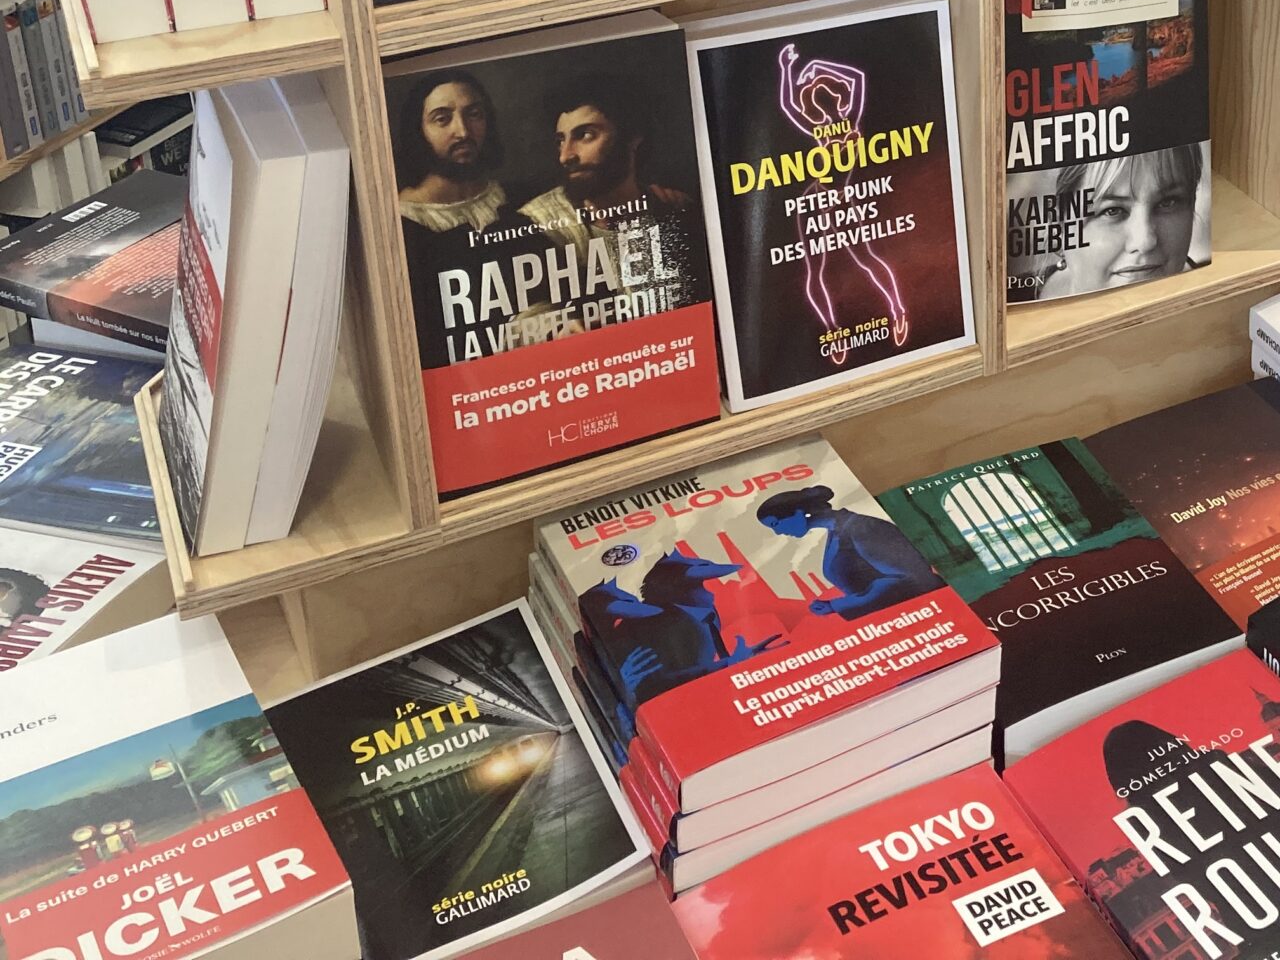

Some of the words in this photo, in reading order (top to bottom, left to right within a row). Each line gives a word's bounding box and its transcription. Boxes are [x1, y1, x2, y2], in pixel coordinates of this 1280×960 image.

[729, 122, 936, 197] DANQUIGNY
[1006, 105, 1131, 170] AFFRIC
[467, 214, 569, 249] Francesco
[574, 194, 649, 226] Fioretti
[784, 190, 841, 218] PETER
[1008, 187, 1095, 229] KARINE
[809, 214, 916, 259] MERVEILLES
[820, 326, 890, 360] GALLIMARD
[451, 374, 536, 408] Francesco
[540, 358, 600, 388] Fioretti
[602, 341, 666, 372] enquête
[555, 381, 588, 405] de
[595, 350, 697, 397] Raphaël
[560, 497, 629, 536] BENOÎT
[1170, 503, 1206, 524] David
[986, 559, 1168, 635] NCORRIGIBLES
[730, 641, 833, 691] Bienvenue
[759, 663, 849, 709] nouveau
[822, 632, 969, 709] Albert-Londres
[349, 695, 481, 766] SMITH
[395, 723, 490, 775] MÉDIUM
[1115, 726, 1246, 800] GÓMEZ-JURADO
[92, 873, 120, 890] de
[192, 806, 279, 849] QUEBERT
[858, 800, 996, 872] TOKYO
[434, 876, 532, 926] GALLIMARD
[827, 833, 1024, 936] REVISITÉE
